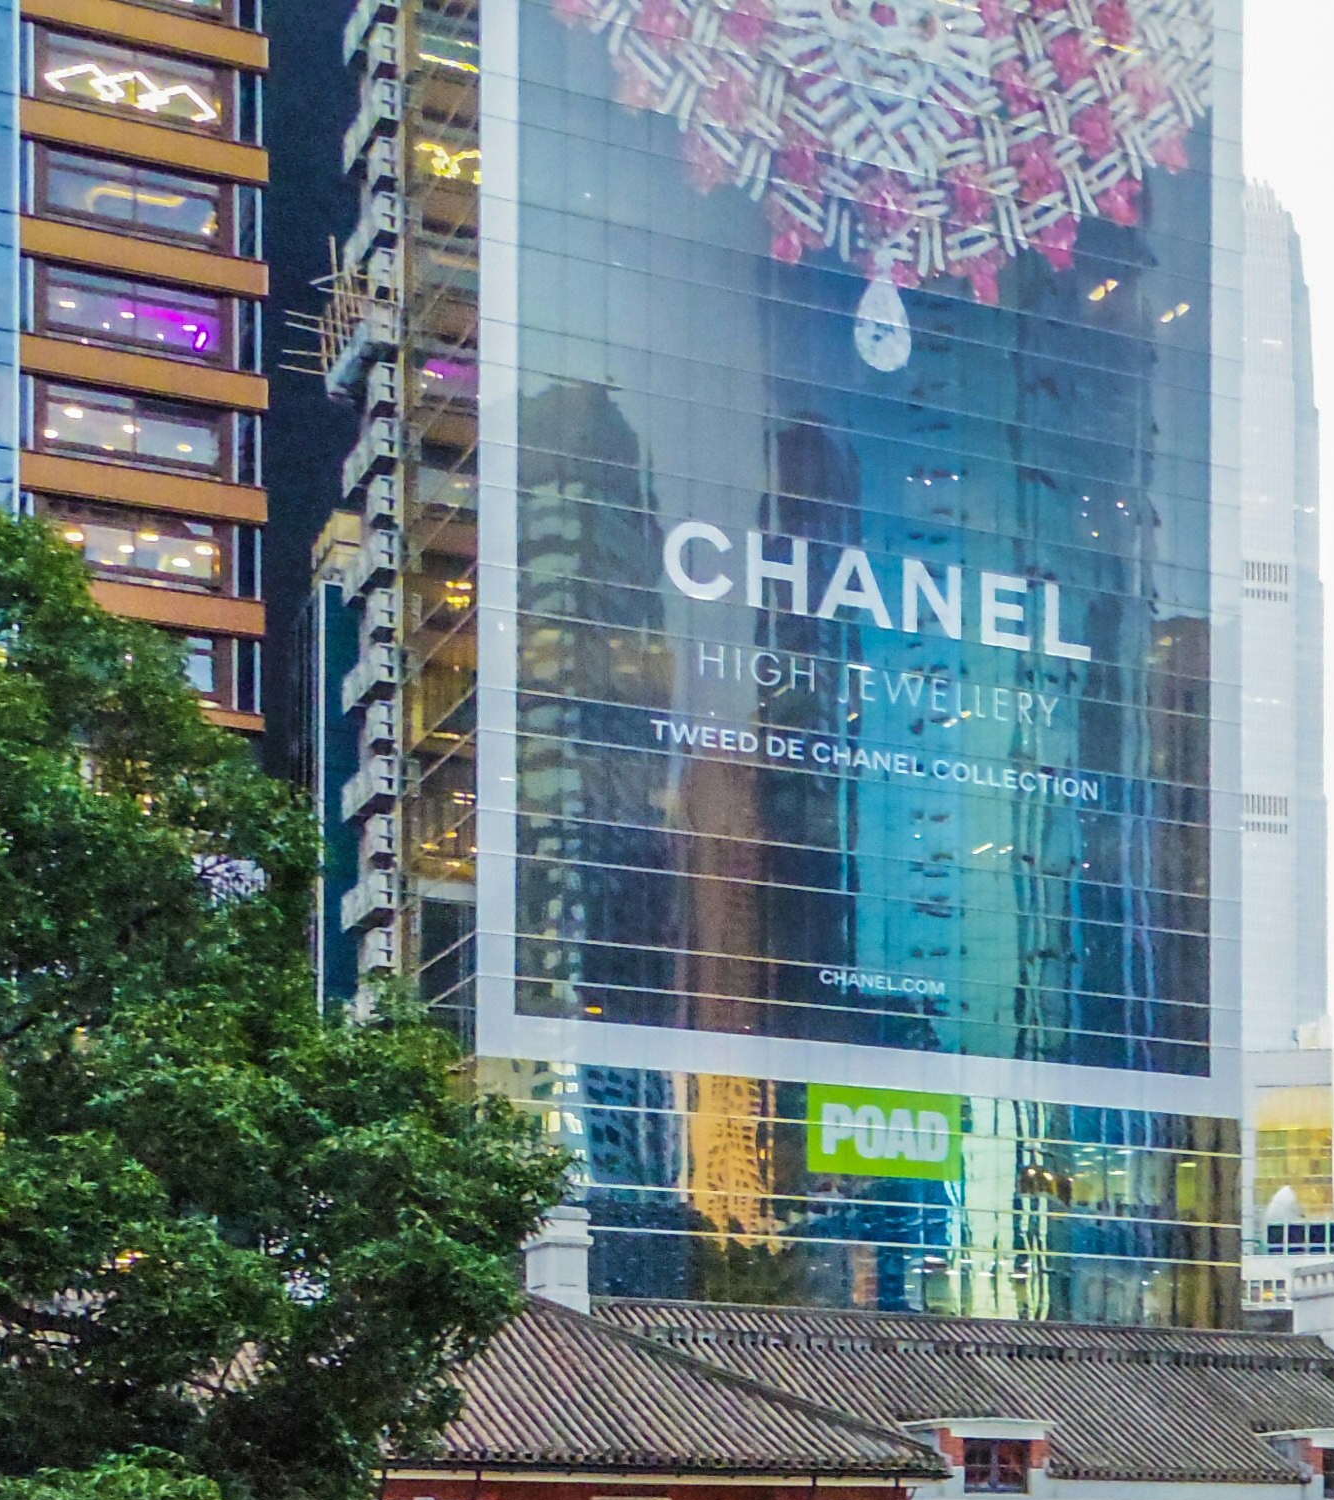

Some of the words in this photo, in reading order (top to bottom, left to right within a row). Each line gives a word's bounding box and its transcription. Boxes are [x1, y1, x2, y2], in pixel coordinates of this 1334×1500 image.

[663, 521, 1092, 661] CHANEL
[698, 642, 815, 692] HIGH
[838, 663, 1059, 728] JEWELLERY
[650, 718, 759, 754] TWEED
[767, 735, 805, 761] DE
[812, 742, 926, 778] CHANEL
[931, 759, 1099, 801] COLLECTION
[819, 970, 946, 995] CHANEL.COM
[822, 1103, 950, 1162] POAD
